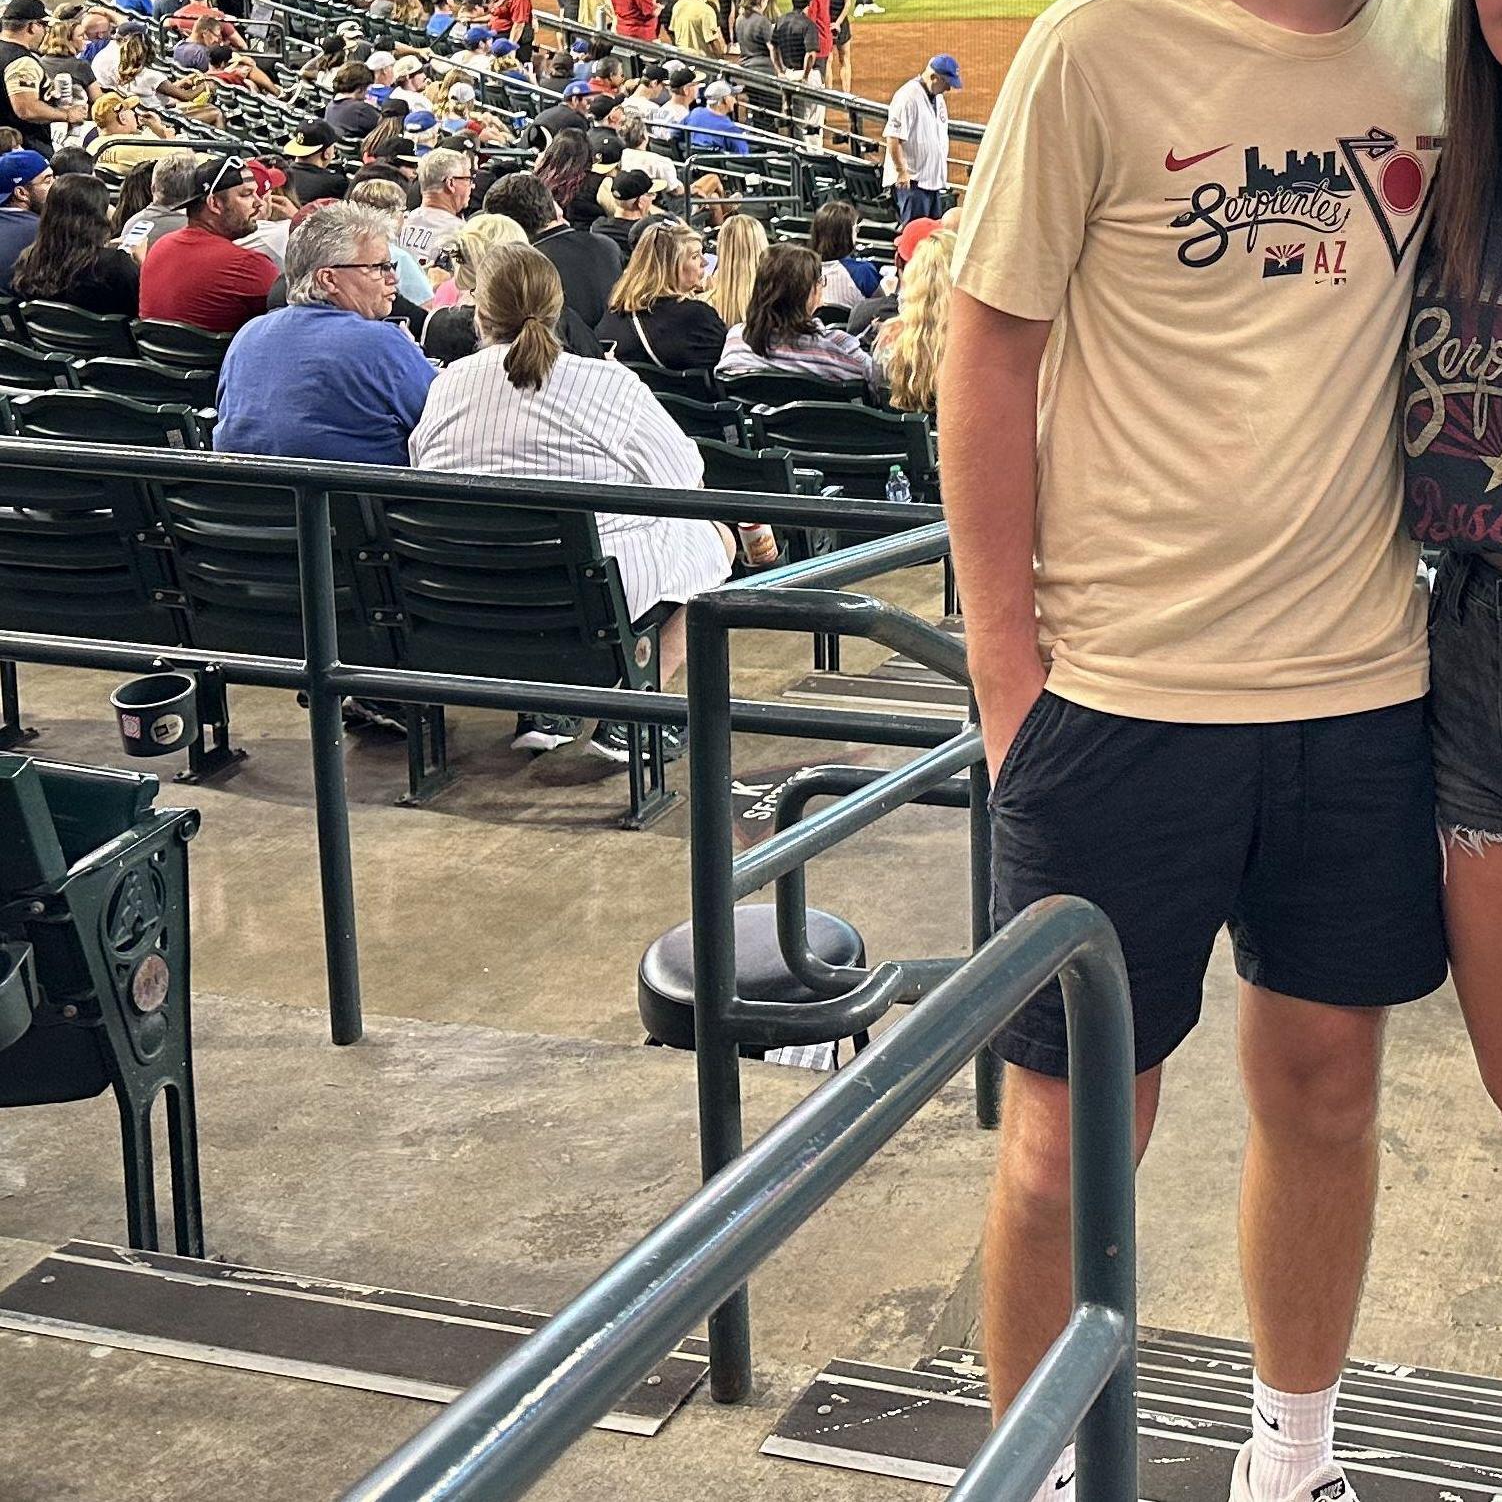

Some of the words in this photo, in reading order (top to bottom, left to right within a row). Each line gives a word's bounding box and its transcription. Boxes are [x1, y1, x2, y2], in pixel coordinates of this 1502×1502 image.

[400, 226, 433, 250] IZZO
[1168, 178, 1352, 268] Serpientes
[1313, 240, 1347, 275] AZ
